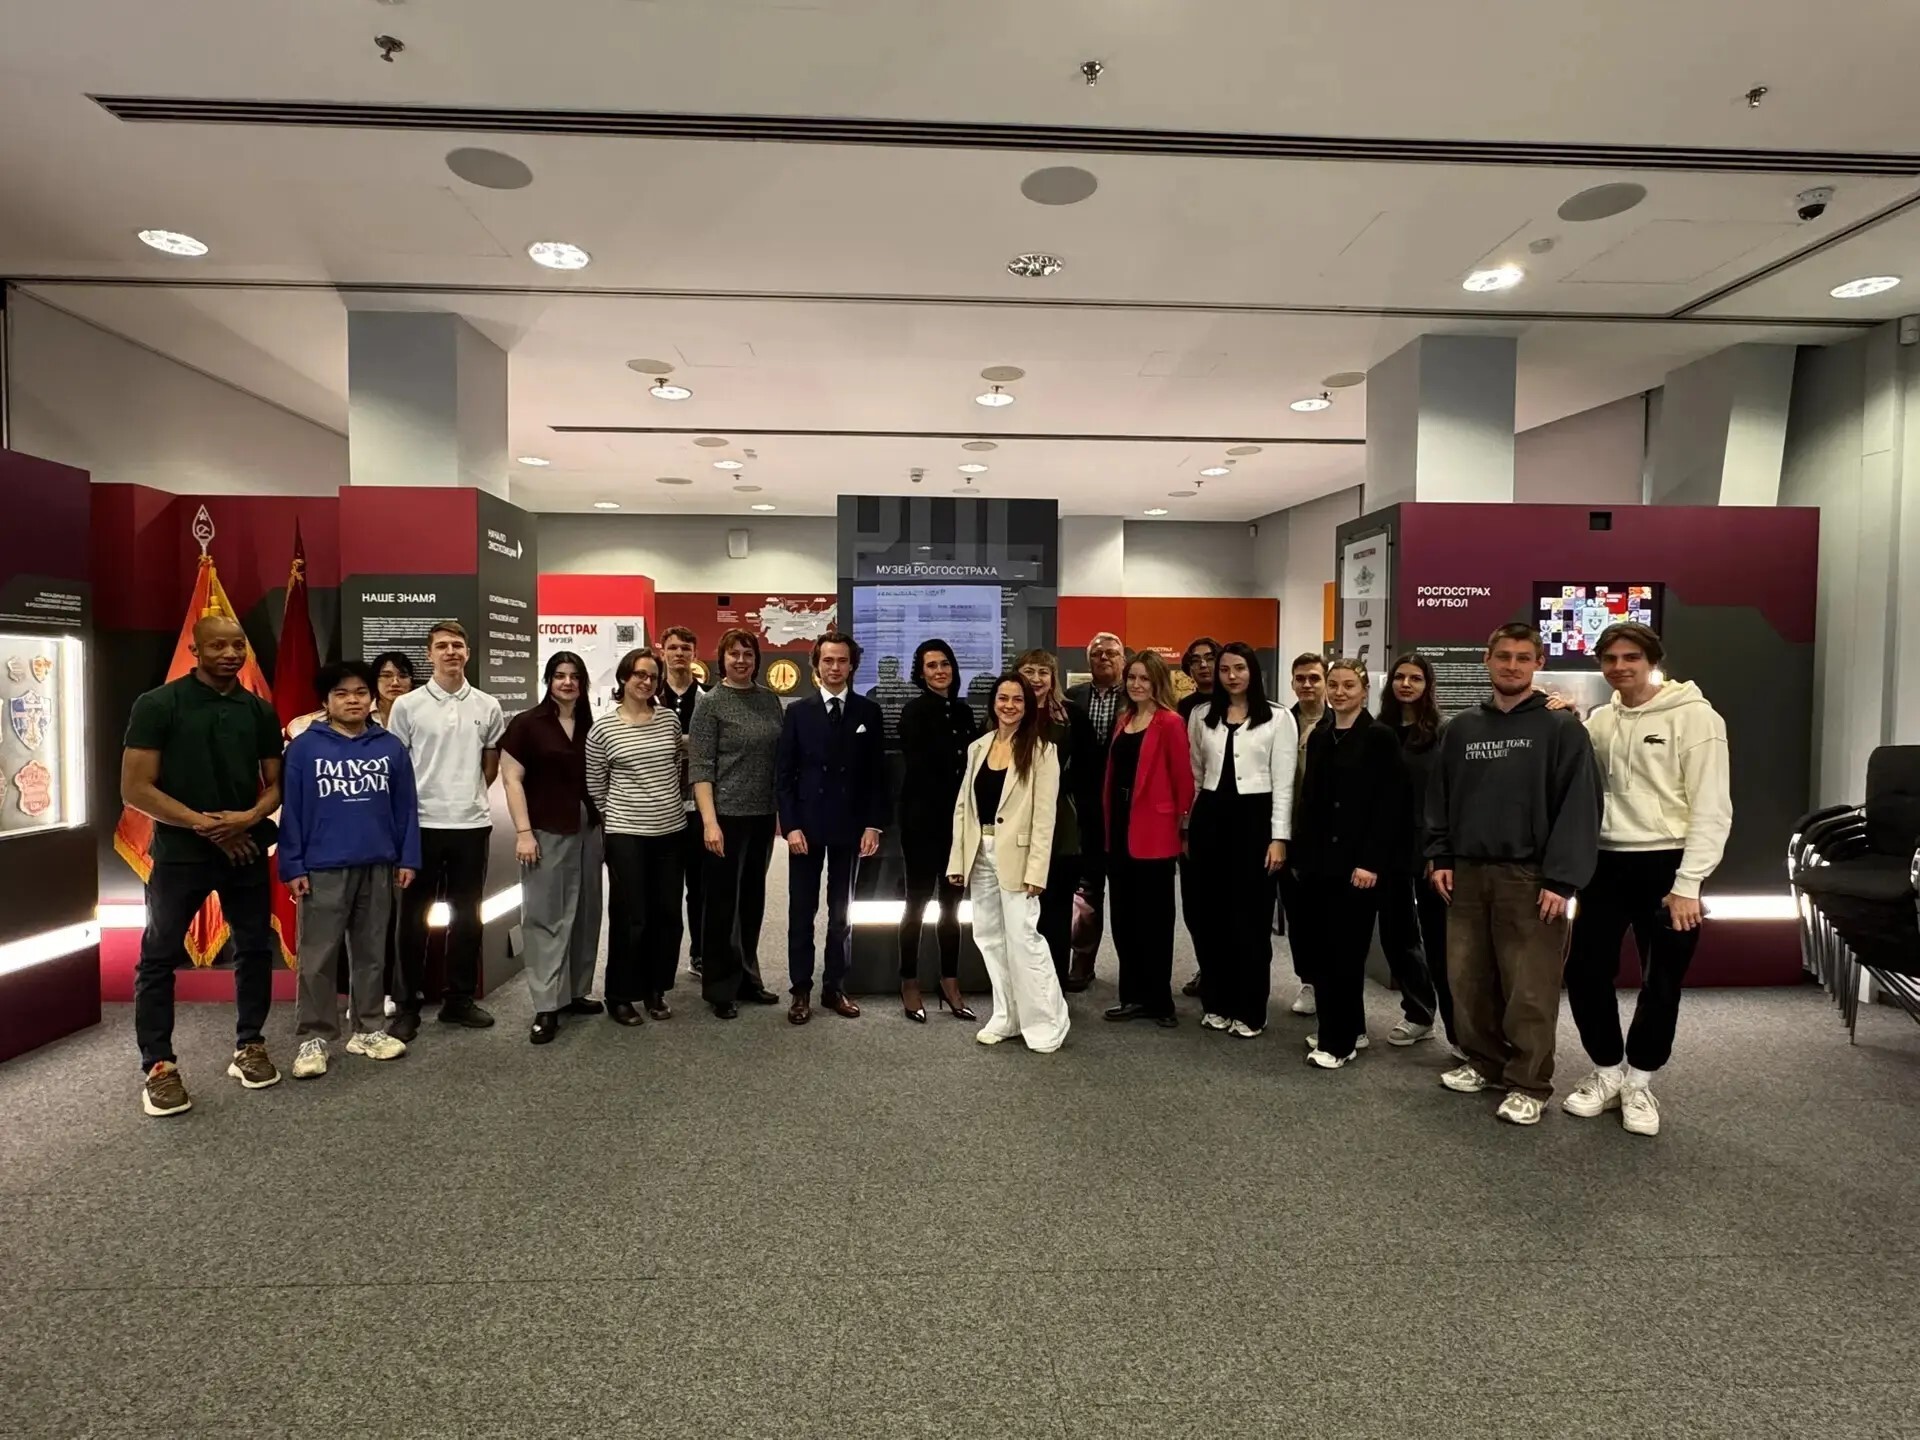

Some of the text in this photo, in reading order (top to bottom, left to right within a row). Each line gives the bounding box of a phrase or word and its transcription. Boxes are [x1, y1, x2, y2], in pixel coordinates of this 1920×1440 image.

[876, 563, 998, 576] МУЗЕЙ РОСГОССТРАХА
[1417, 586, 1491, 597] РОСГОССТРАХ
[362, 593, 436, 603] НАШЕ ЗНАМЯ
[1417, 598, 1468, 607] И ФУТБОЛ
[538, 624, 597, 635] СГОССТРАХ
[548, 636, 573, 644] МУЗЕЙ
[1466, 740, 1504, 752] БОГАТЫЕ
[1465, 748, 1509, 760] СТРАДАЮТ
[314, 756, 391, 778] IM NOT
[316, 773, 390, 798] DRUNK
